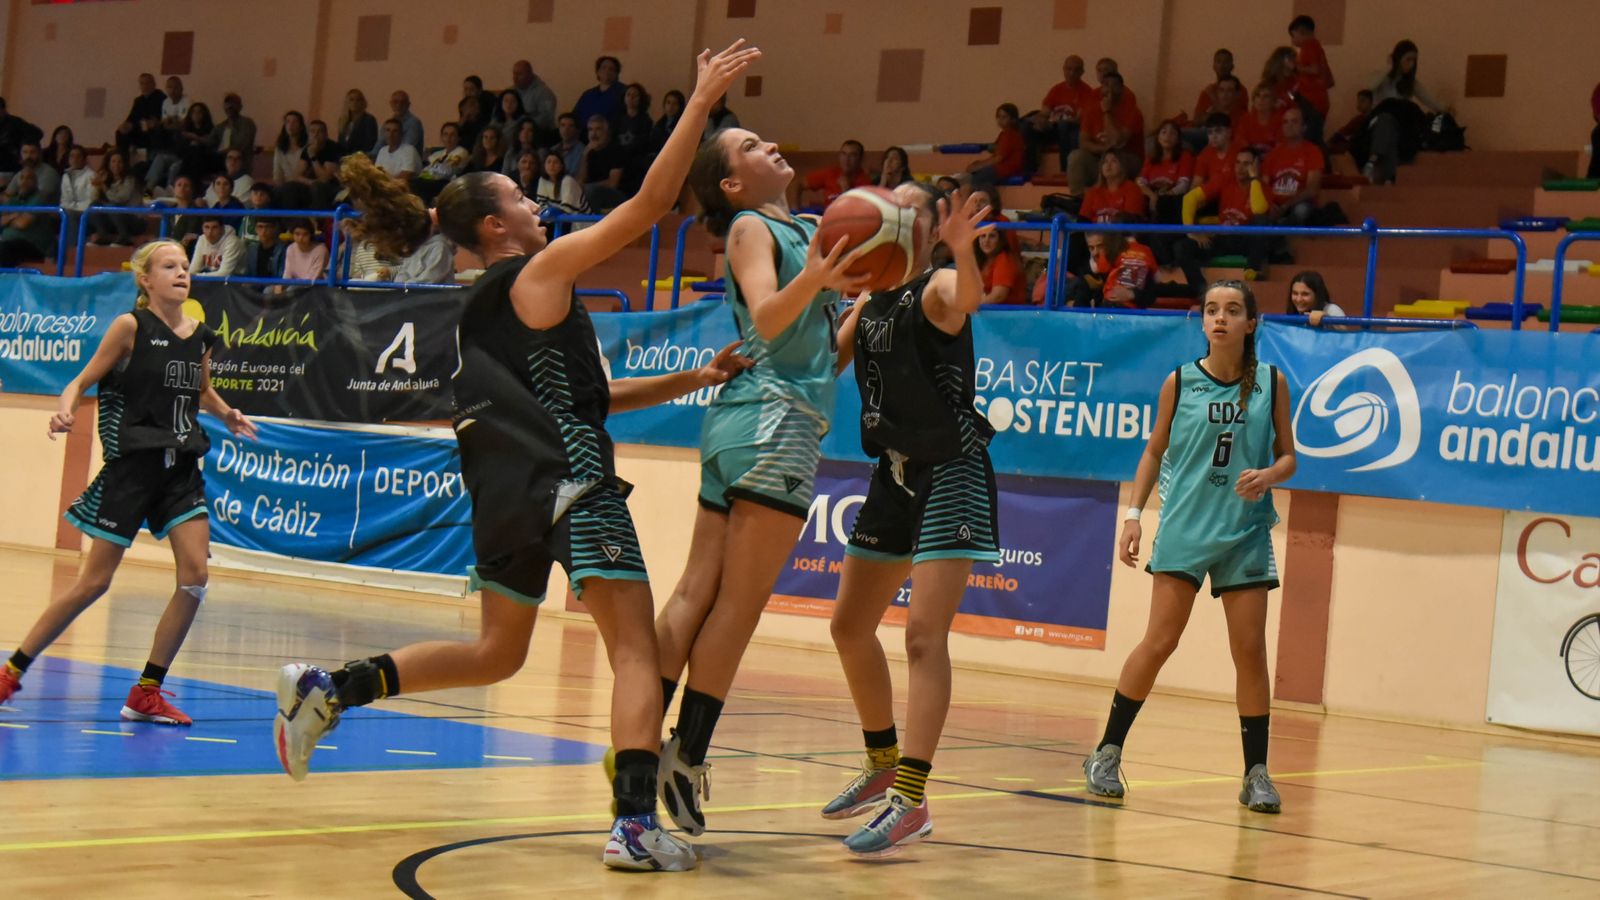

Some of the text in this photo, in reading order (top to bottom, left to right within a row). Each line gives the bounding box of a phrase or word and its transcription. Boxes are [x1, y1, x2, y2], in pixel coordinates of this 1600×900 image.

[240, 361, 286, 376] Europea
[289, 363, 305, 376] del
[257, 378, 284, 392] 2021
[346, 378, 376, 391] Junta
[378, 379, 391, 391] de
[974, 357, 1103, 396] BASKET
[1447, 370, 1600, 424] balonc
[216, 439, 350, 489] Diputación
[1211, 431, 1234, 468] 6
[1439, 423, 1600, 472] andalu
[213, 490, 321, 537] de Cádiz
[855, 531, 879, 545] vive
[793, 556, 825, 572] JOSÉ
